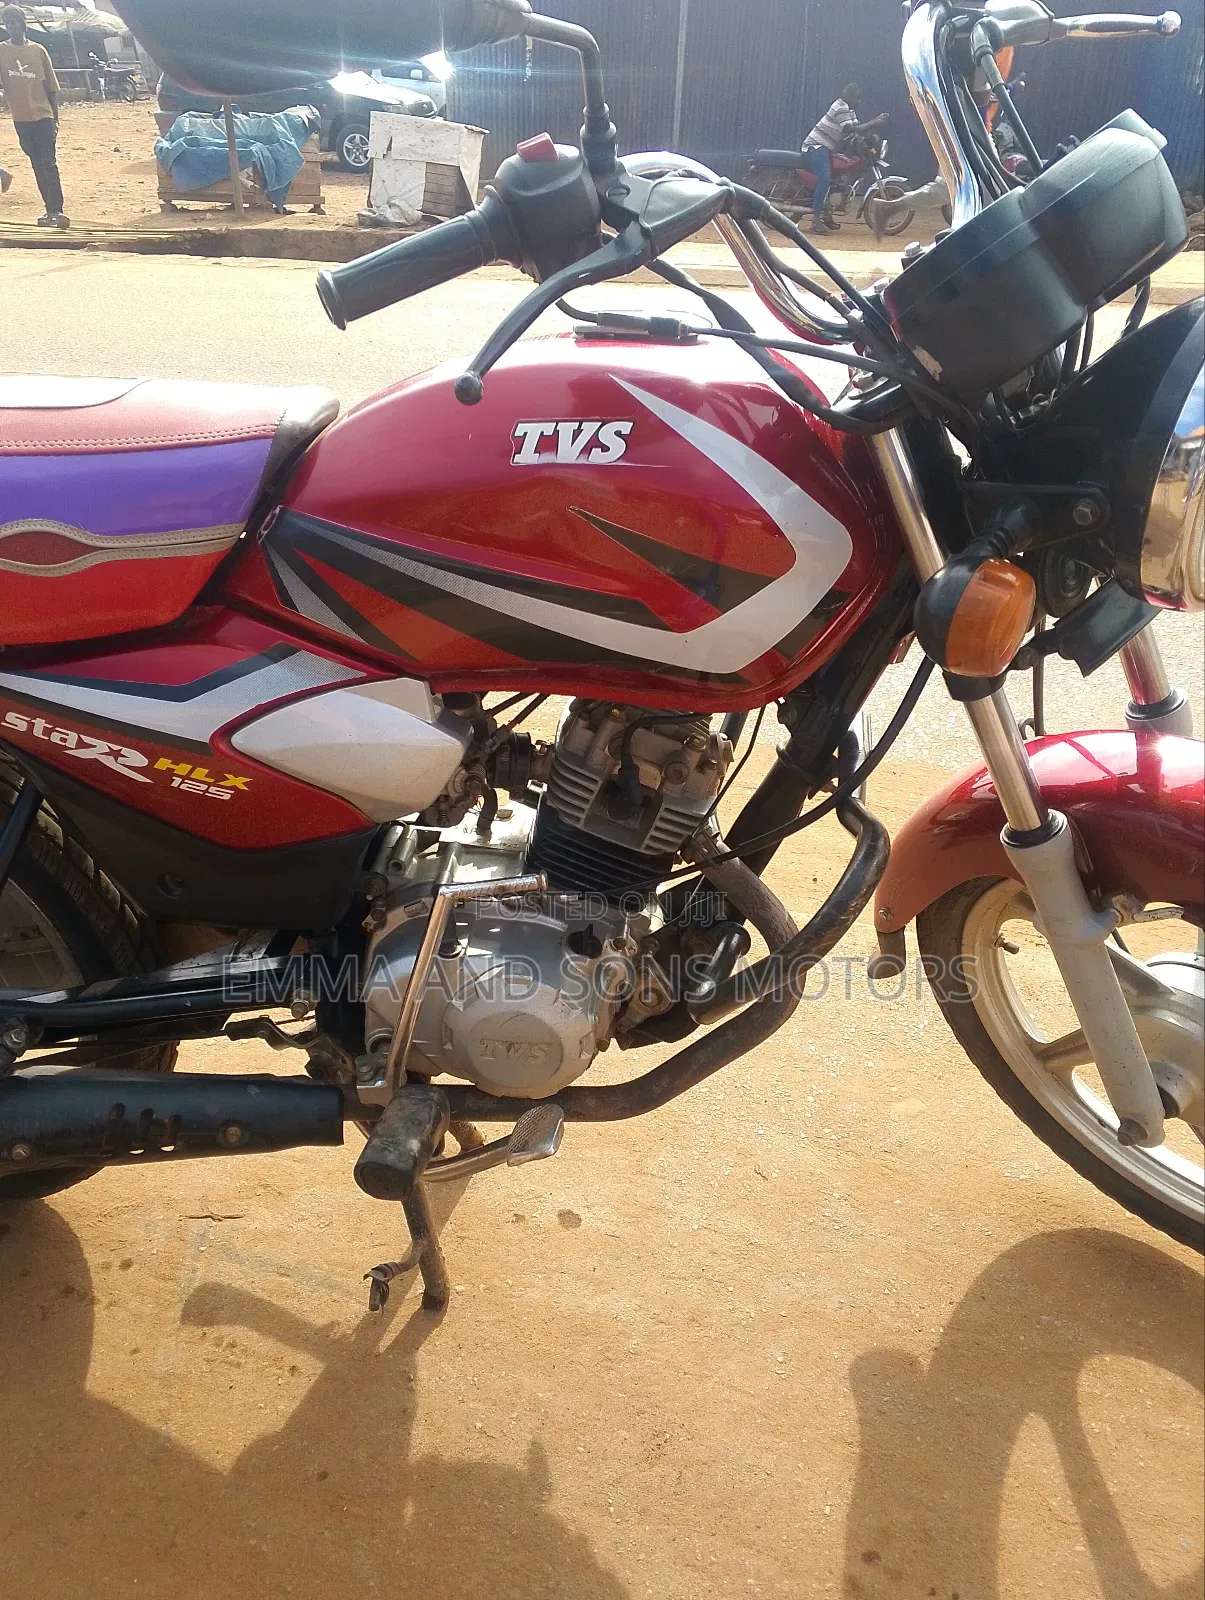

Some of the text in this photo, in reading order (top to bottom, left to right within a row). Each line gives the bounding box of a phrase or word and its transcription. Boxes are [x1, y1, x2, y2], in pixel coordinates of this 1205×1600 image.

[513, 420, 634, 464] TVS
[154, 757, 252, 790] HLX
[170, 776, 234, 800] 125
[479, 1038, 550, 1063] TVS
